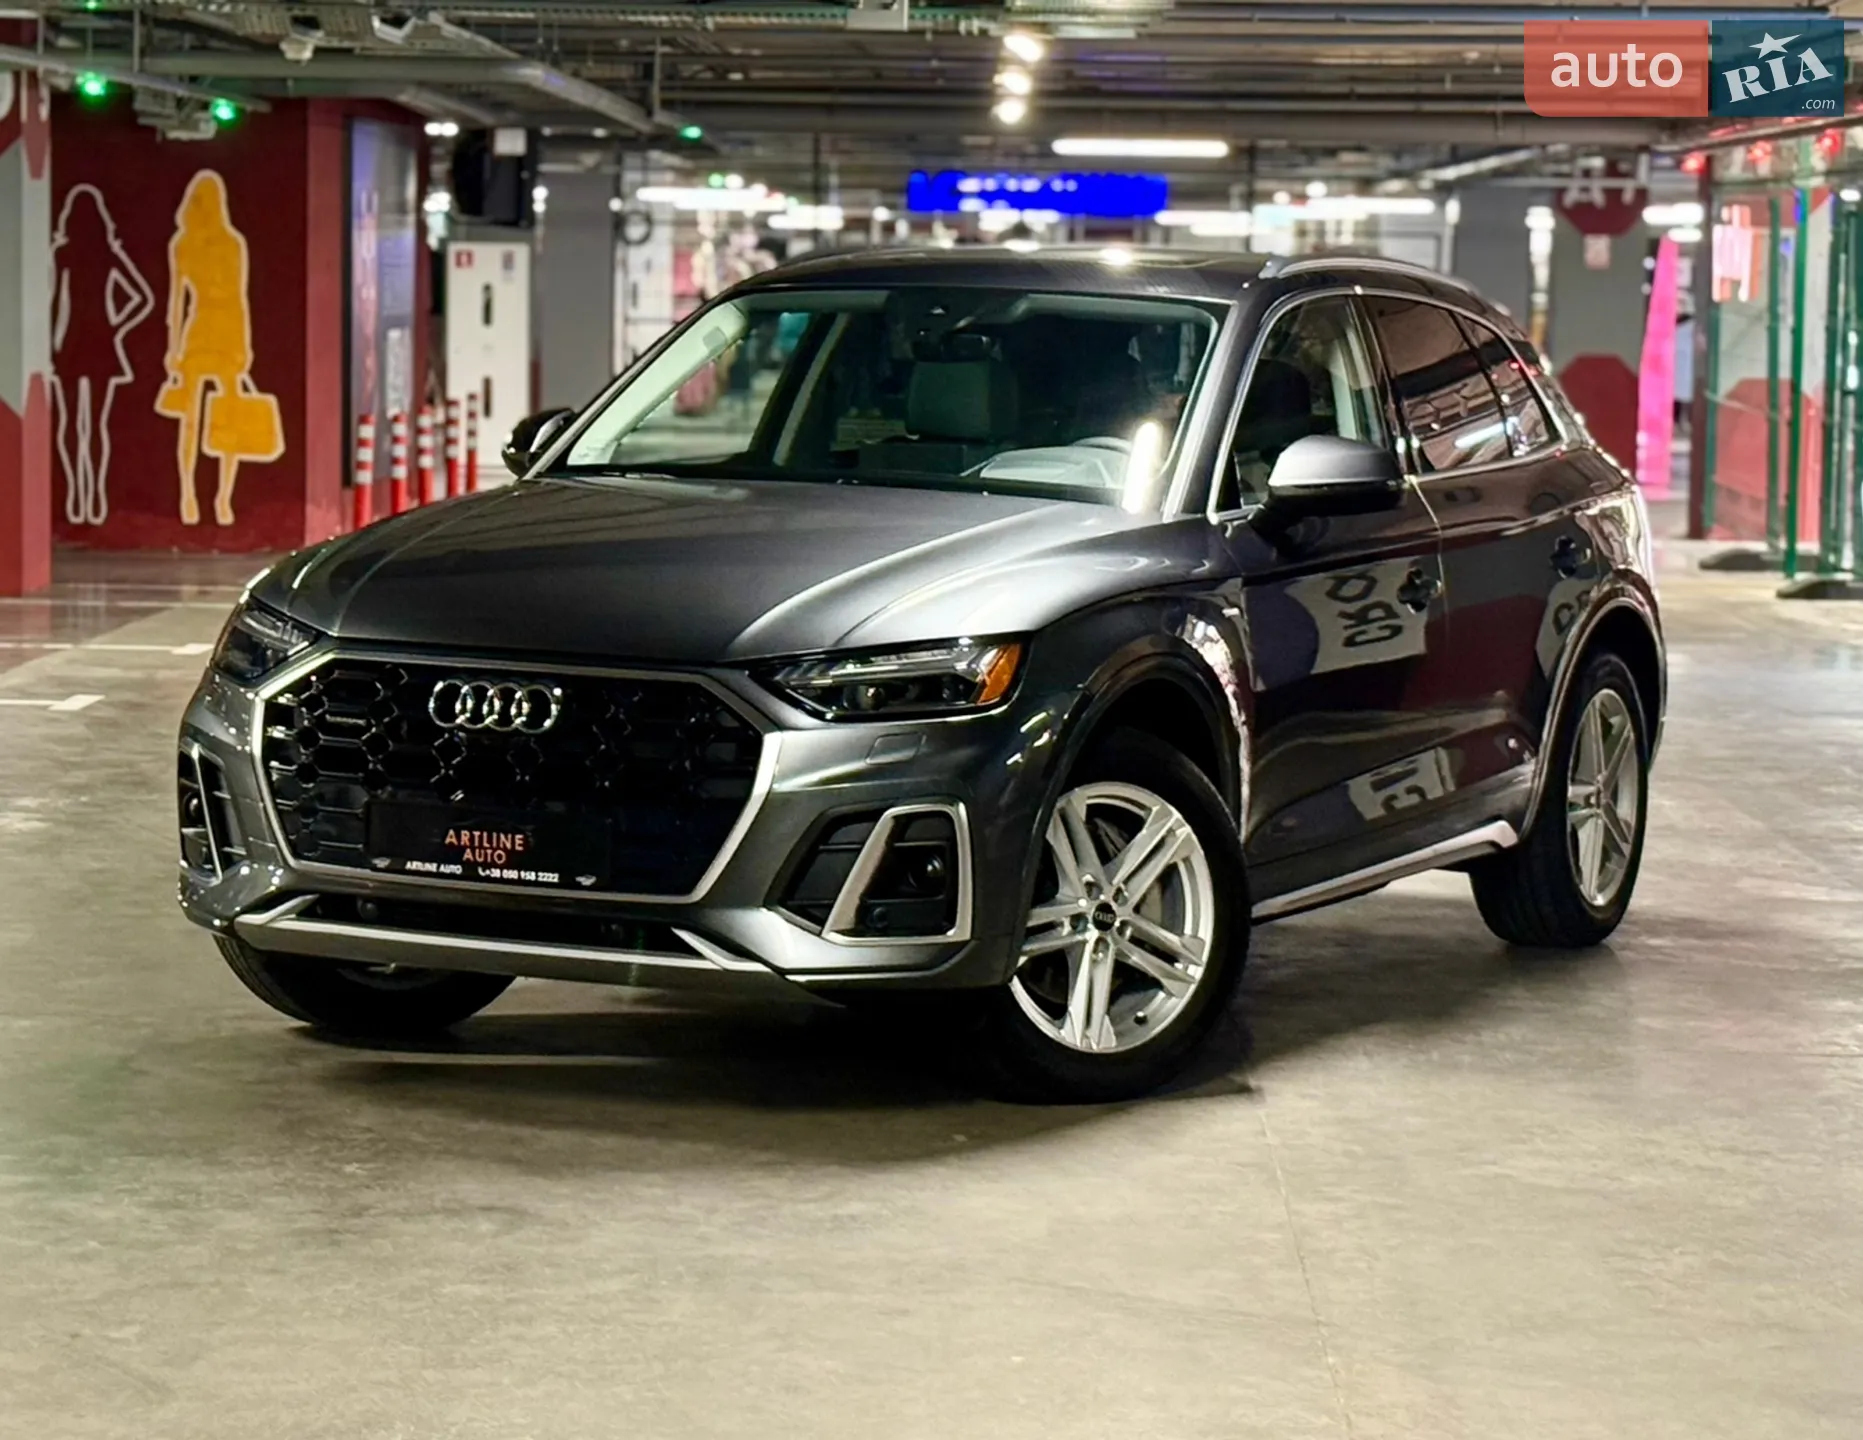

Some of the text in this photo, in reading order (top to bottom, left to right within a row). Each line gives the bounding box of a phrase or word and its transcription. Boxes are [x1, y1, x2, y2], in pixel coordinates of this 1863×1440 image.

[444, 829, 524, 851] ARTLINE
[462, 848, 506, 864] AUTO
[405, 861, 463, 874] ARTLINE AUTO
[537, 872, 559, 882] 2222
